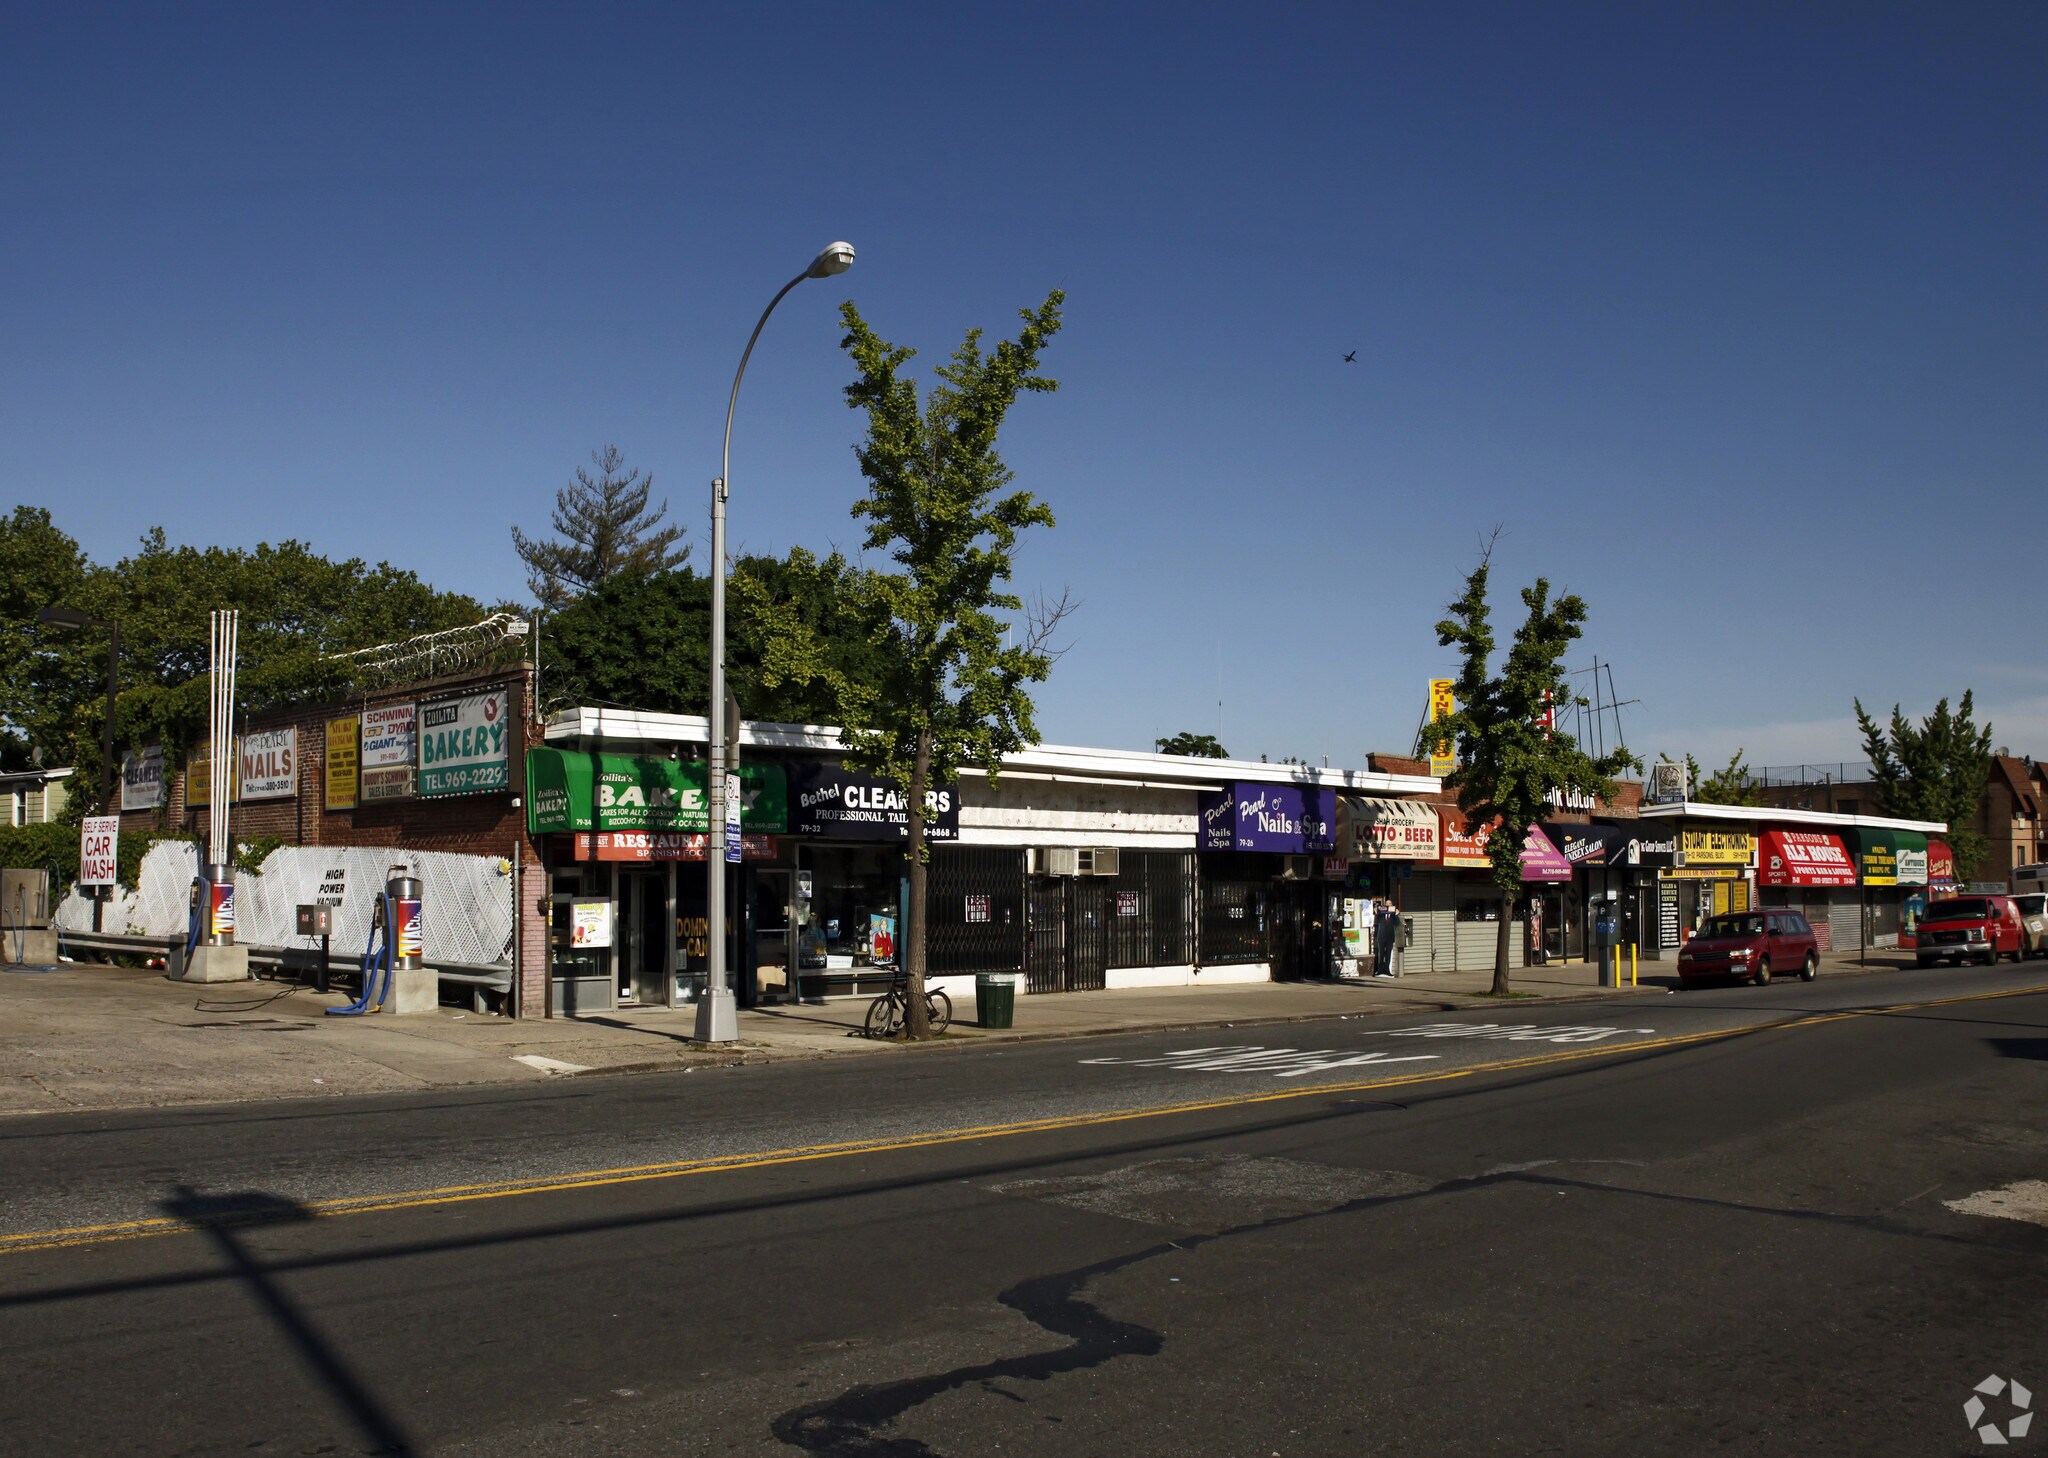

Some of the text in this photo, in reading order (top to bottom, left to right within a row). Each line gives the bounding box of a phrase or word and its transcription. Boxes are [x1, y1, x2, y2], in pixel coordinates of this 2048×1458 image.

[366, 707, 413, 724] SCHWINN
[426, 706, 456, 725] ZOILITA
[364, 721, 416, 738] GT DYNO
[260, 733, 288, 750] PEARL
[369, 737, 397, 751] GIANT
[423, 721, 504, 764] BAKERY
[243, 748, 292, 780] NAILS
[125, 764, 162, 786] CLEANERS
[364, 770, 408, 786] BUDDY'S SCHWINN
[425, 766, 502, 790] TEL.969-2229
[596, 773, 634, 783] Zoilita's
[368, 785, 380, 797] SALES
[385, 784, 403, 796] SERVICE
[537, 788, 564, 799] Zoilita's
[593, 784, 761, 811] BAKEY
[800, 783, 840, 807] Bethel
[536, 797, 567, 815] BAKERY
[600, 808, 617, 817] CAKES
[617, 808, 629, 816] FOR
[630, 808, 641, 816] ALL
[643, 810, 676, 818] OCCASION
[1204, 792, 1234, 825] Pearl
[1240, 791, 1266, 822] Pearl
[608, 818, 637, 826] BIZCOCHO
[656, 819, 677, 827] TODAS
[815, 809, 885, 823] PROFESSIONAL
[1376, 817, 1415, 827] SHAH GROCERY
[83, 820, 117, 834] SELF SERVE
[800, 824, 821, 833] 79-32
[1208, 828, 1231, 838] Nails
[1257, 811, 1327, 839] Nails & Spa
[1355, 825, 1434, 843] LOTTO BEER
[1684, 831, 1748, 850] STUART ELECTRONICS
[1790, 832, 1823, 844] PARSONS
[85, 836, 111, 857] CAR
[1239, 839, 1254, 847] 79-26
[1446, 846, 1460, 854] CHINESE
[1564, 838, 1586, 854] ELEGANT
[1565, 845, 1585, 863] UNISEX
[1585, 838, 1603, 856] SALON
[636, 849, 680, 857] SPANISH
[1782, 844, 1847, 863] ALE HOUSE
[82, 859, 115, 880] WASH
[1325, 857, 1348, 870] ATM
[1793, 866, 1816, 875] SPORTS
[1831, 868, 1853, 876] LOUNGE
[325, 869, 345, 880] HIGH
[318, 883, 345, 894] POWER
[319, 912, 328, 929] AIR
